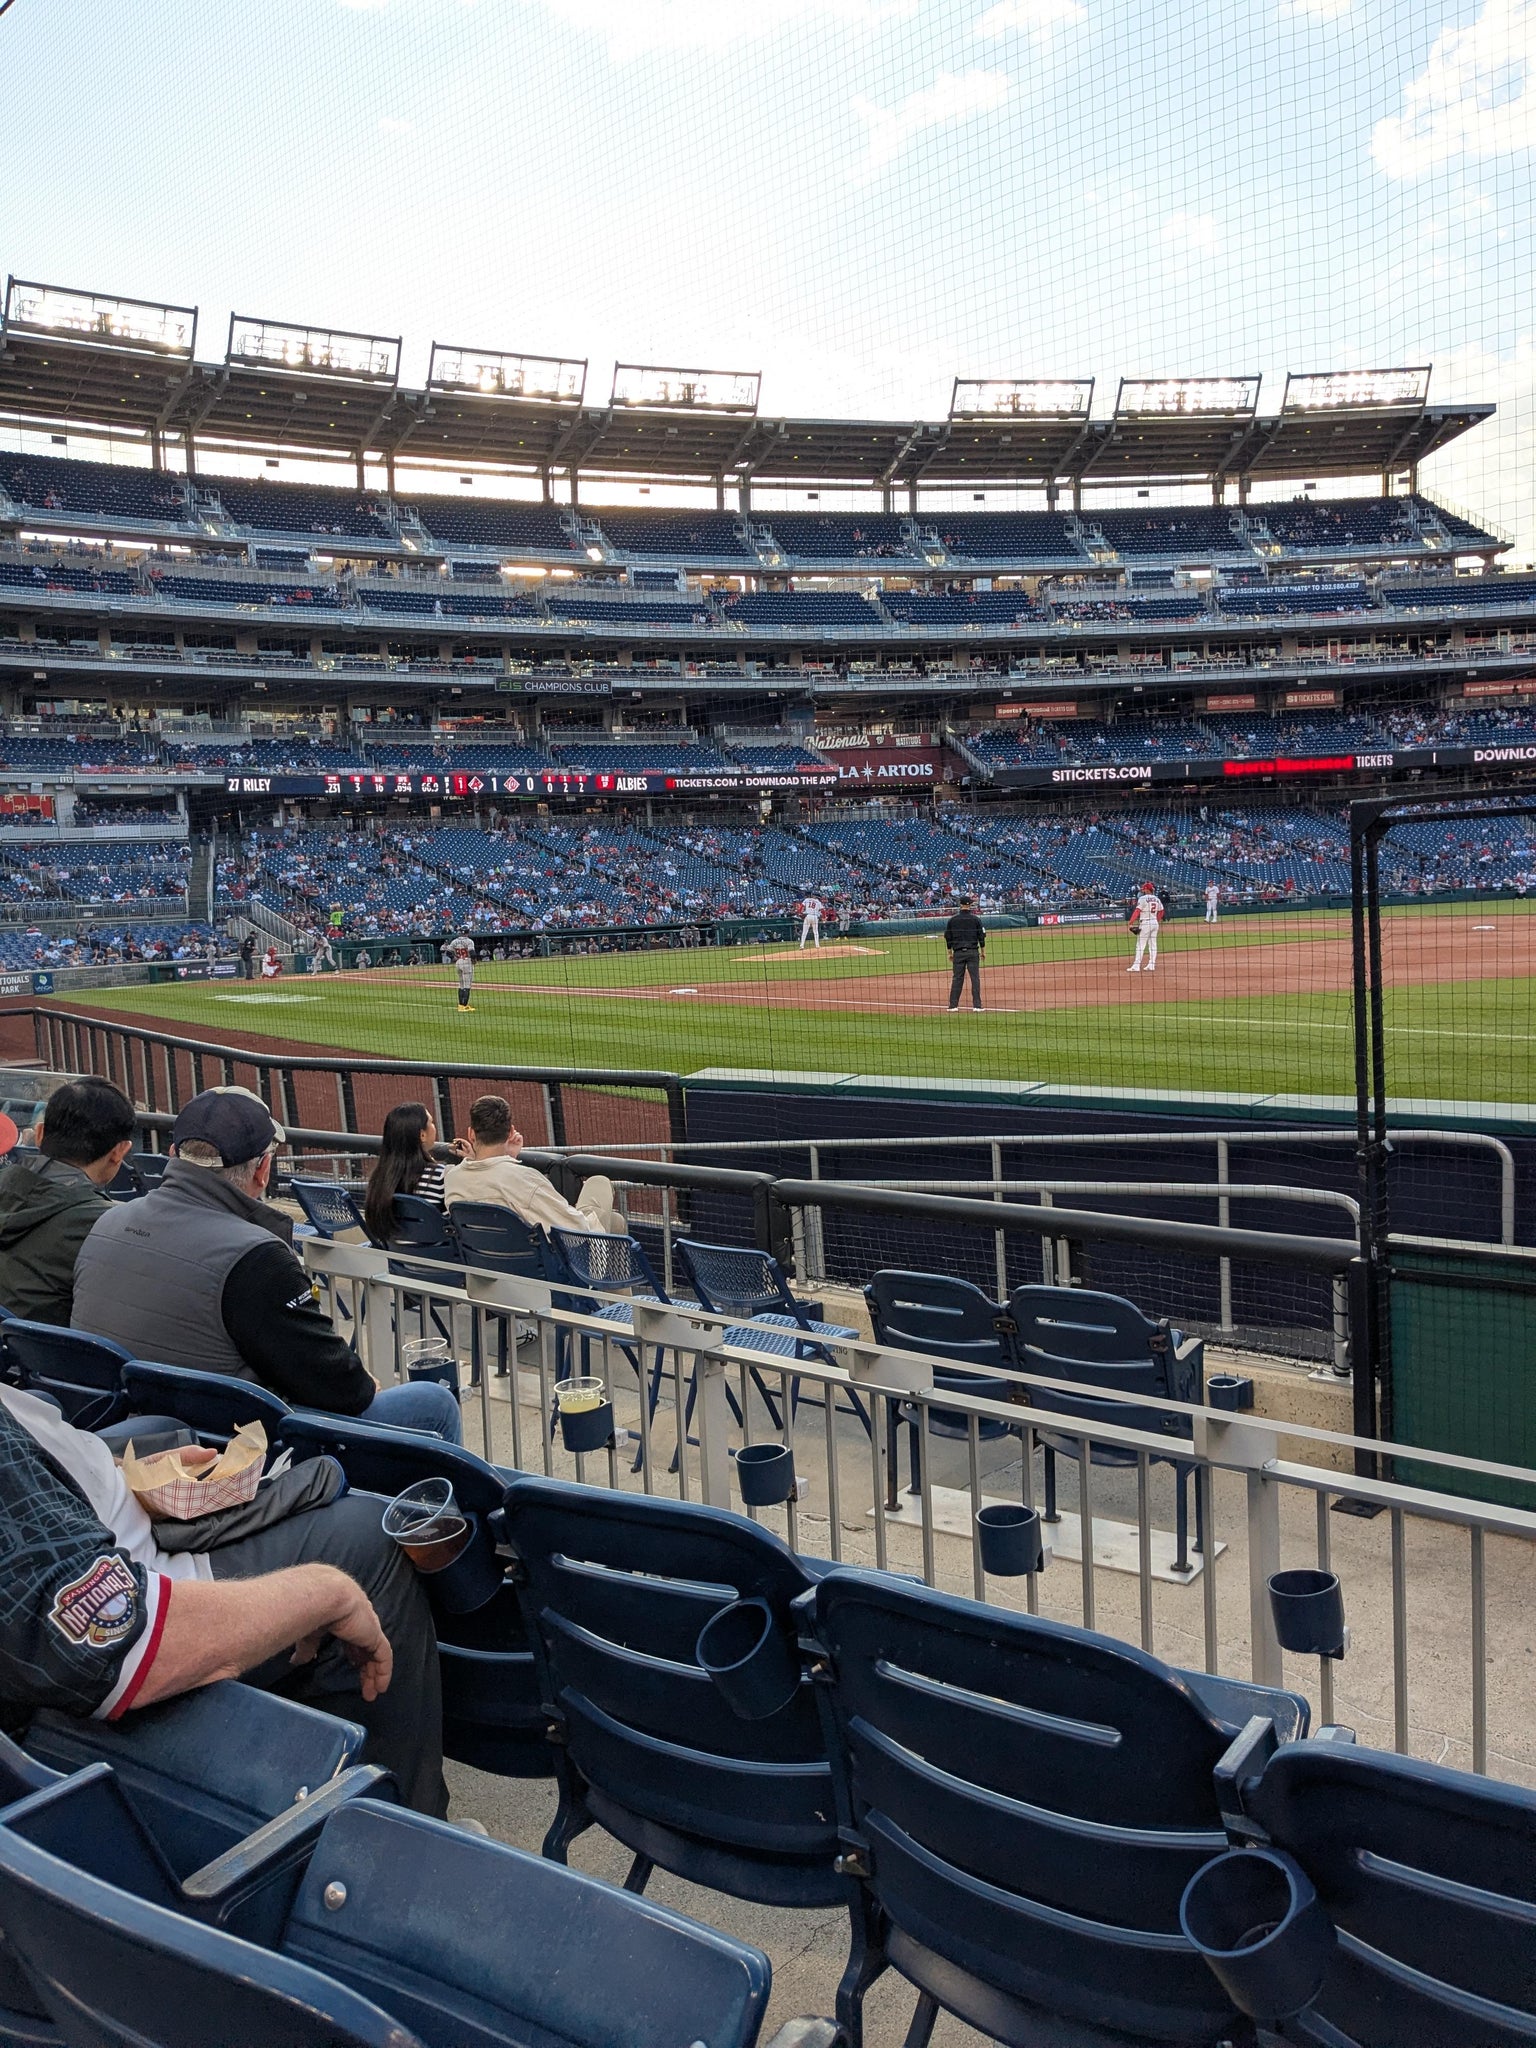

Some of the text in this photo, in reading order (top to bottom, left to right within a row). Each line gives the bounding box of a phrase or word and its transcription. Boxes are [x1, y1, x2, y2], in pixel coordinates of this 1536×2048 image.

[524, 681, 582, 691] CHAMPIONS
[584, 683, 610, 692] CLUB
[804, 735, 870, 749] Nationals
[1355, 754, 1394, 768] TICKETS
[877, 763, 934, 777] ARTOIS
[228, 778, 271, 792] 27 RILEY
[324, 783, 341, 793] .231
[375, 783, 385, 793] 16
[491, 777, 498, 791] 1
[526, 777, 534, 791] 0
[547, 783, 585, 793] 0 2 2
[616, 777, 648, 791] ALBIES
[745, 776, 800, 787] DOWNLOAD
[801, 776, 818, 785] THE
[819, 775, 838, 785] APP
[1, 985, 20, 994] PARK
[63, 1563, 110, 1602] WASHINGTON
[61, 1565, 135, 1635] NATIONALS
